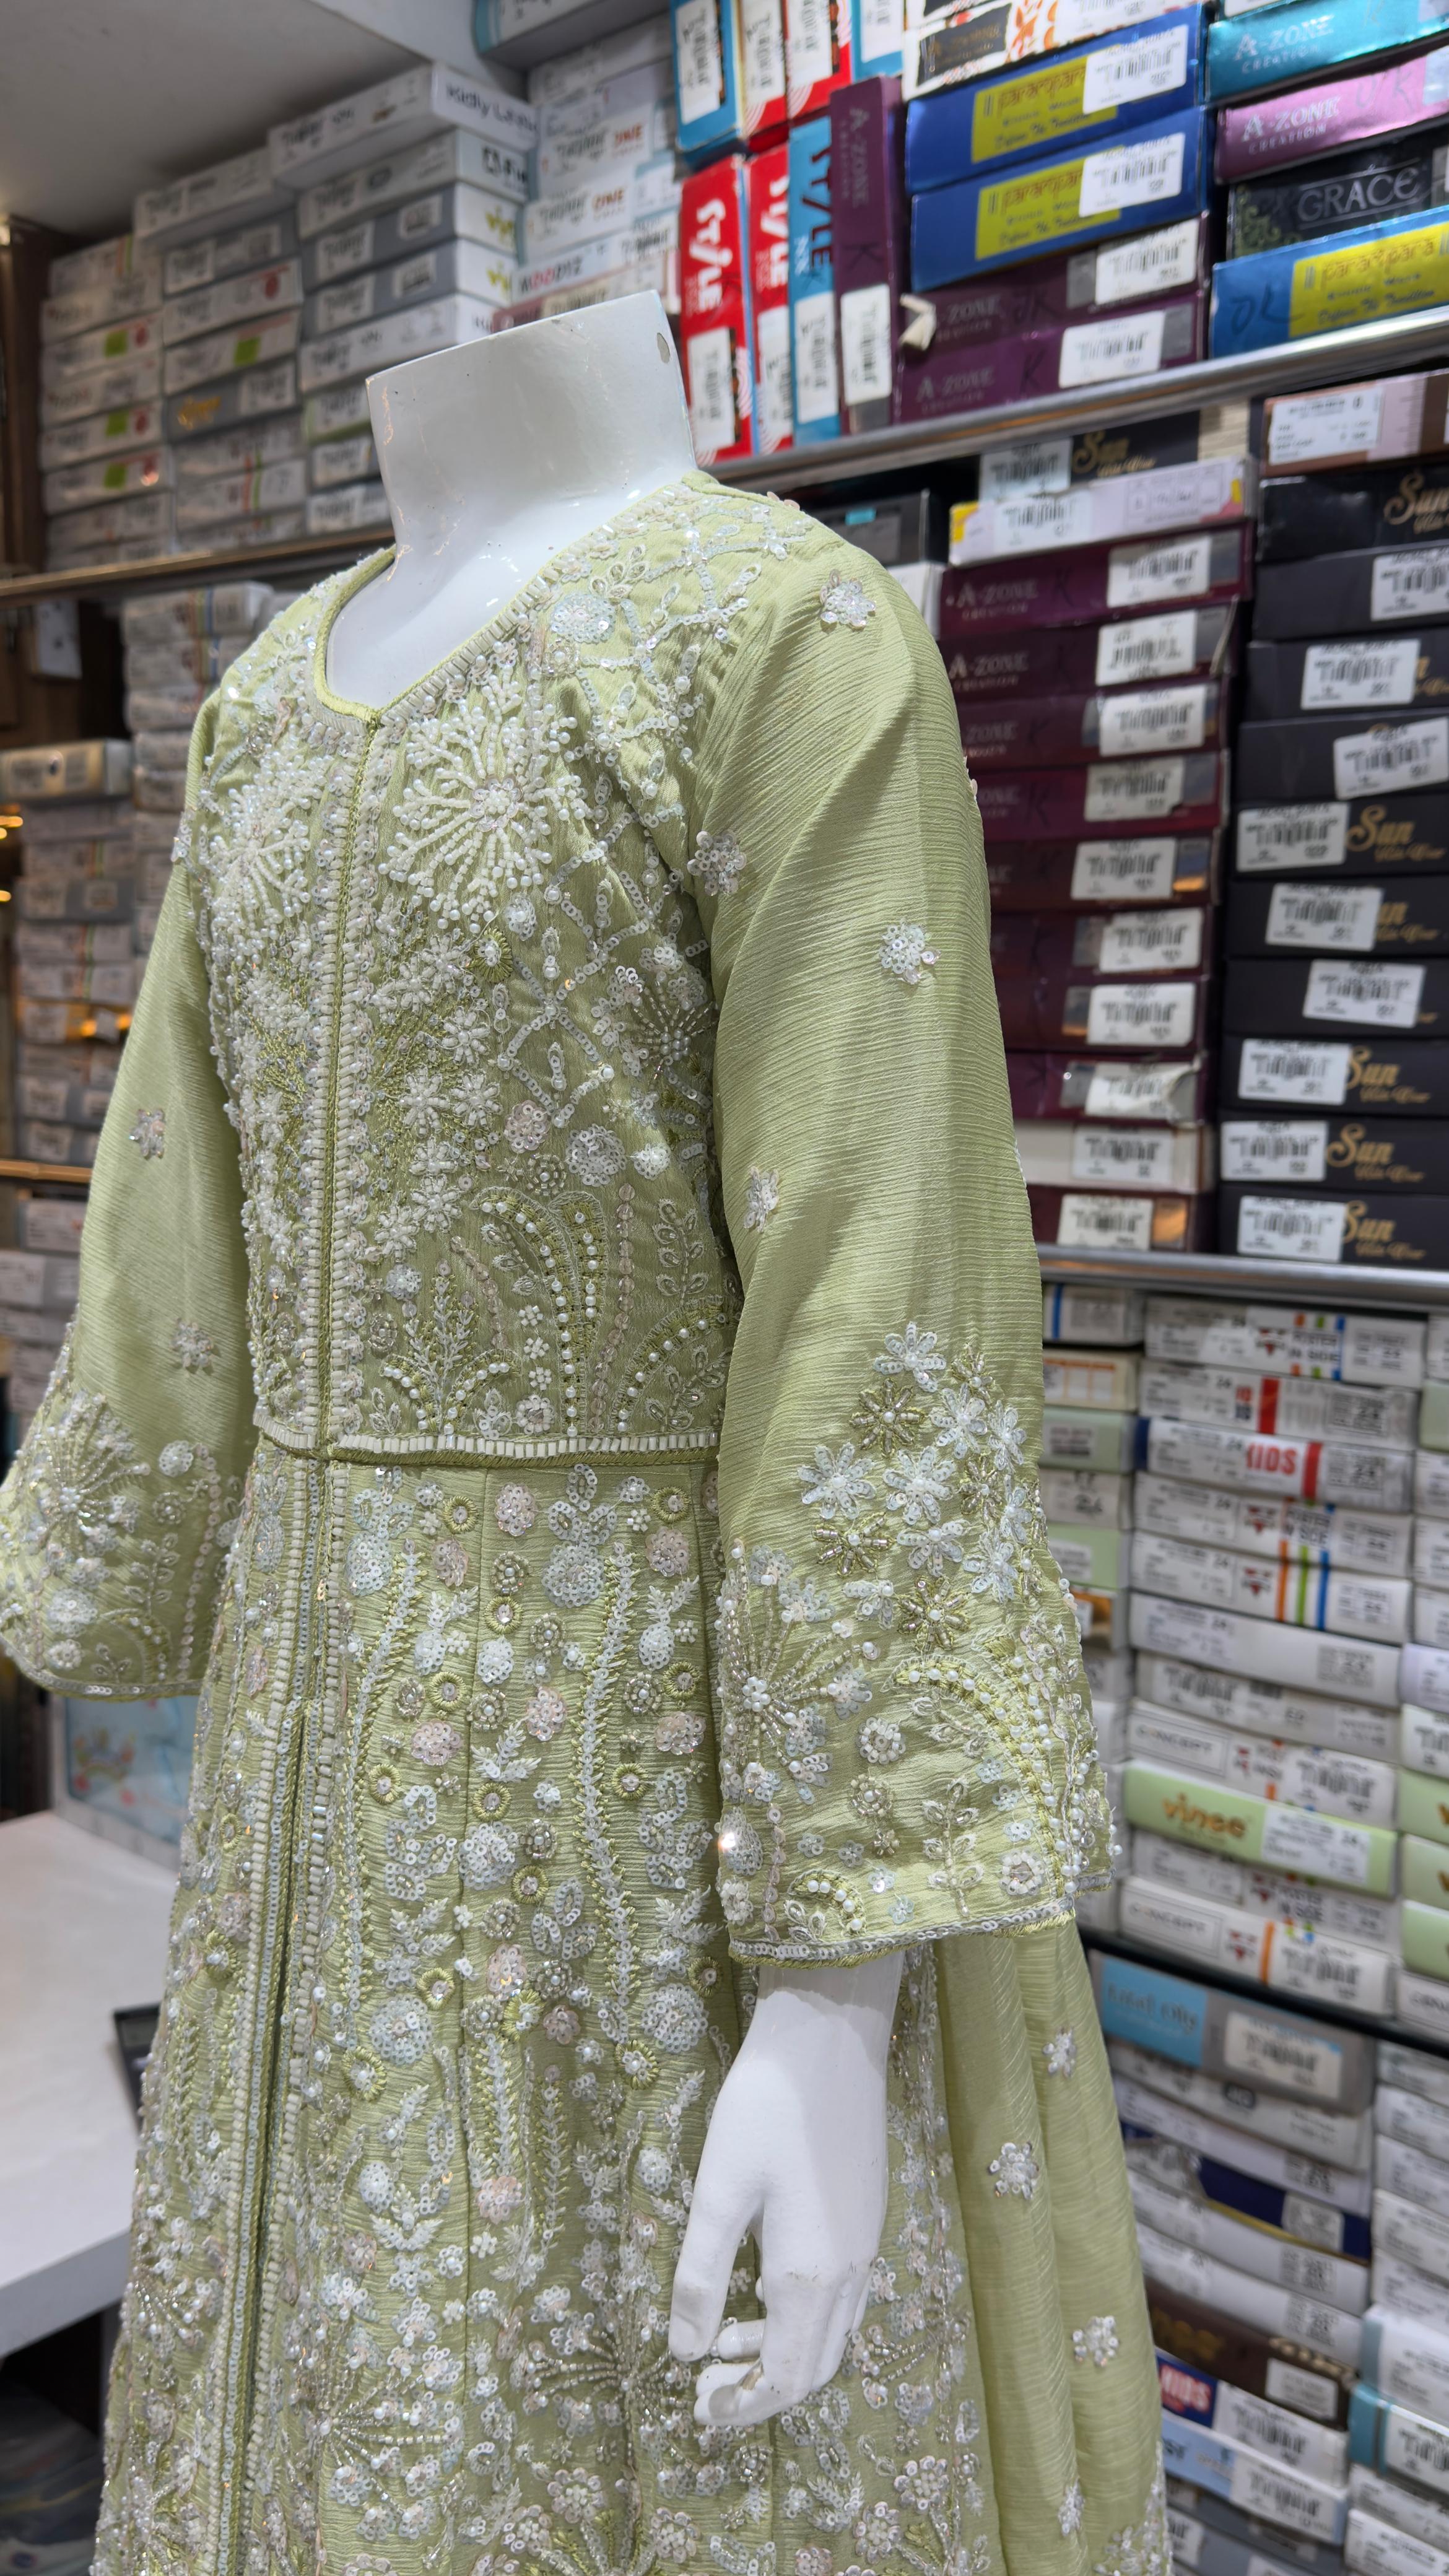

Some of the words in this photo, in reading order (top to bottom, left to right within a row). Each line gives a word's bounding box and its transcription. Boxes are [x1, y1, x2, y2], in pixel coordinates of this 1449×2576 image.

[1235, 14, 1334, 61] A-ZONE
[1242, 95, 1341, 142] A-ZONE
[1248, 124, 1326, 154] CREATION
[1297, 167, 1419, 222] GRACE
[1346, 804, 1415, 852] Sun
[1327, 1123, 1394, 1168] Sun
